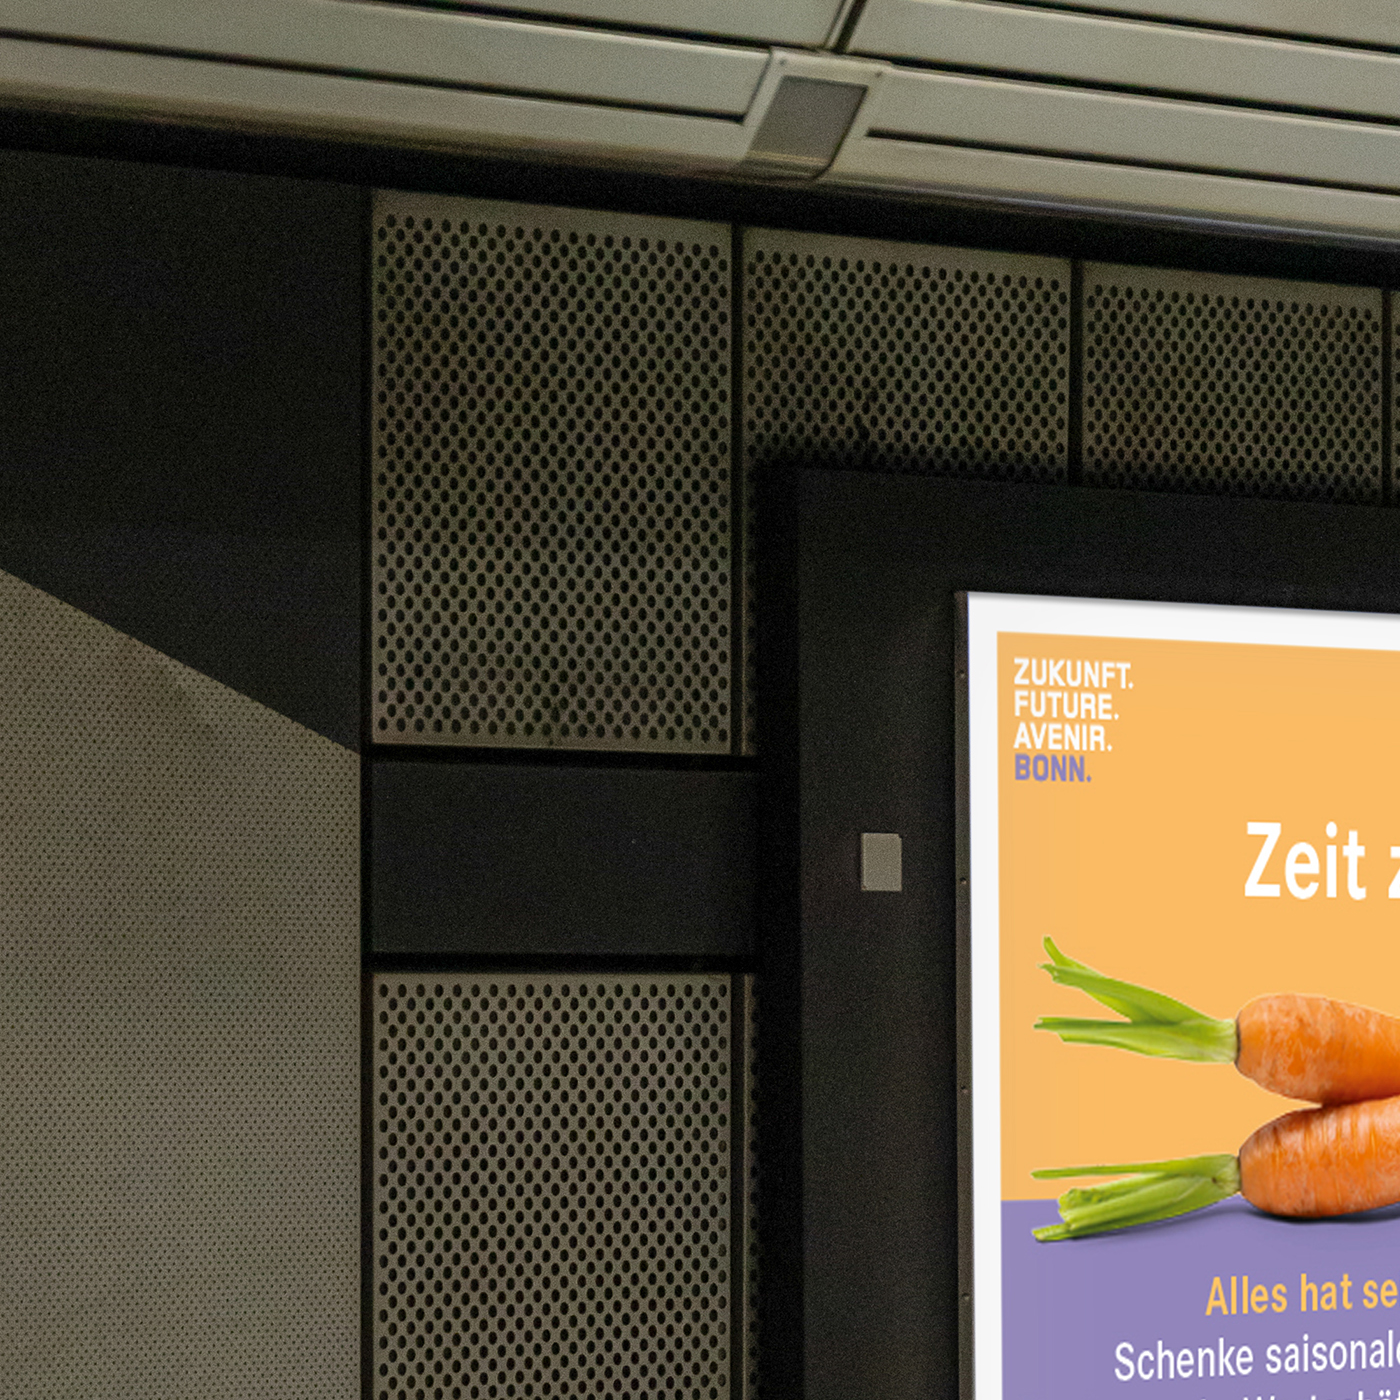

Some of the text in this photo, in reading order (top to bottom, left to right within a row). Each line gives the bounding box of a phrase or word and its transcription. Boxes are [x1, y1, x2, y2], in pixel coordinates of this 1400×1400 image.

[1014, 657, 1134, 689] ZUKUNFT.
[1014, 689, 1120, 720] FUTURE.
[1013, 721, 1113, 752] AVENIR.
[1014, 753, 1092, 783] BONN.
[1244, 821, 1367, 901] Zeit
[1205, 1275, 1288, 1316] Alles
[1300, 1273, 1353, 1312] hat
[1114, 1337, 1254, 1382] Schenke
